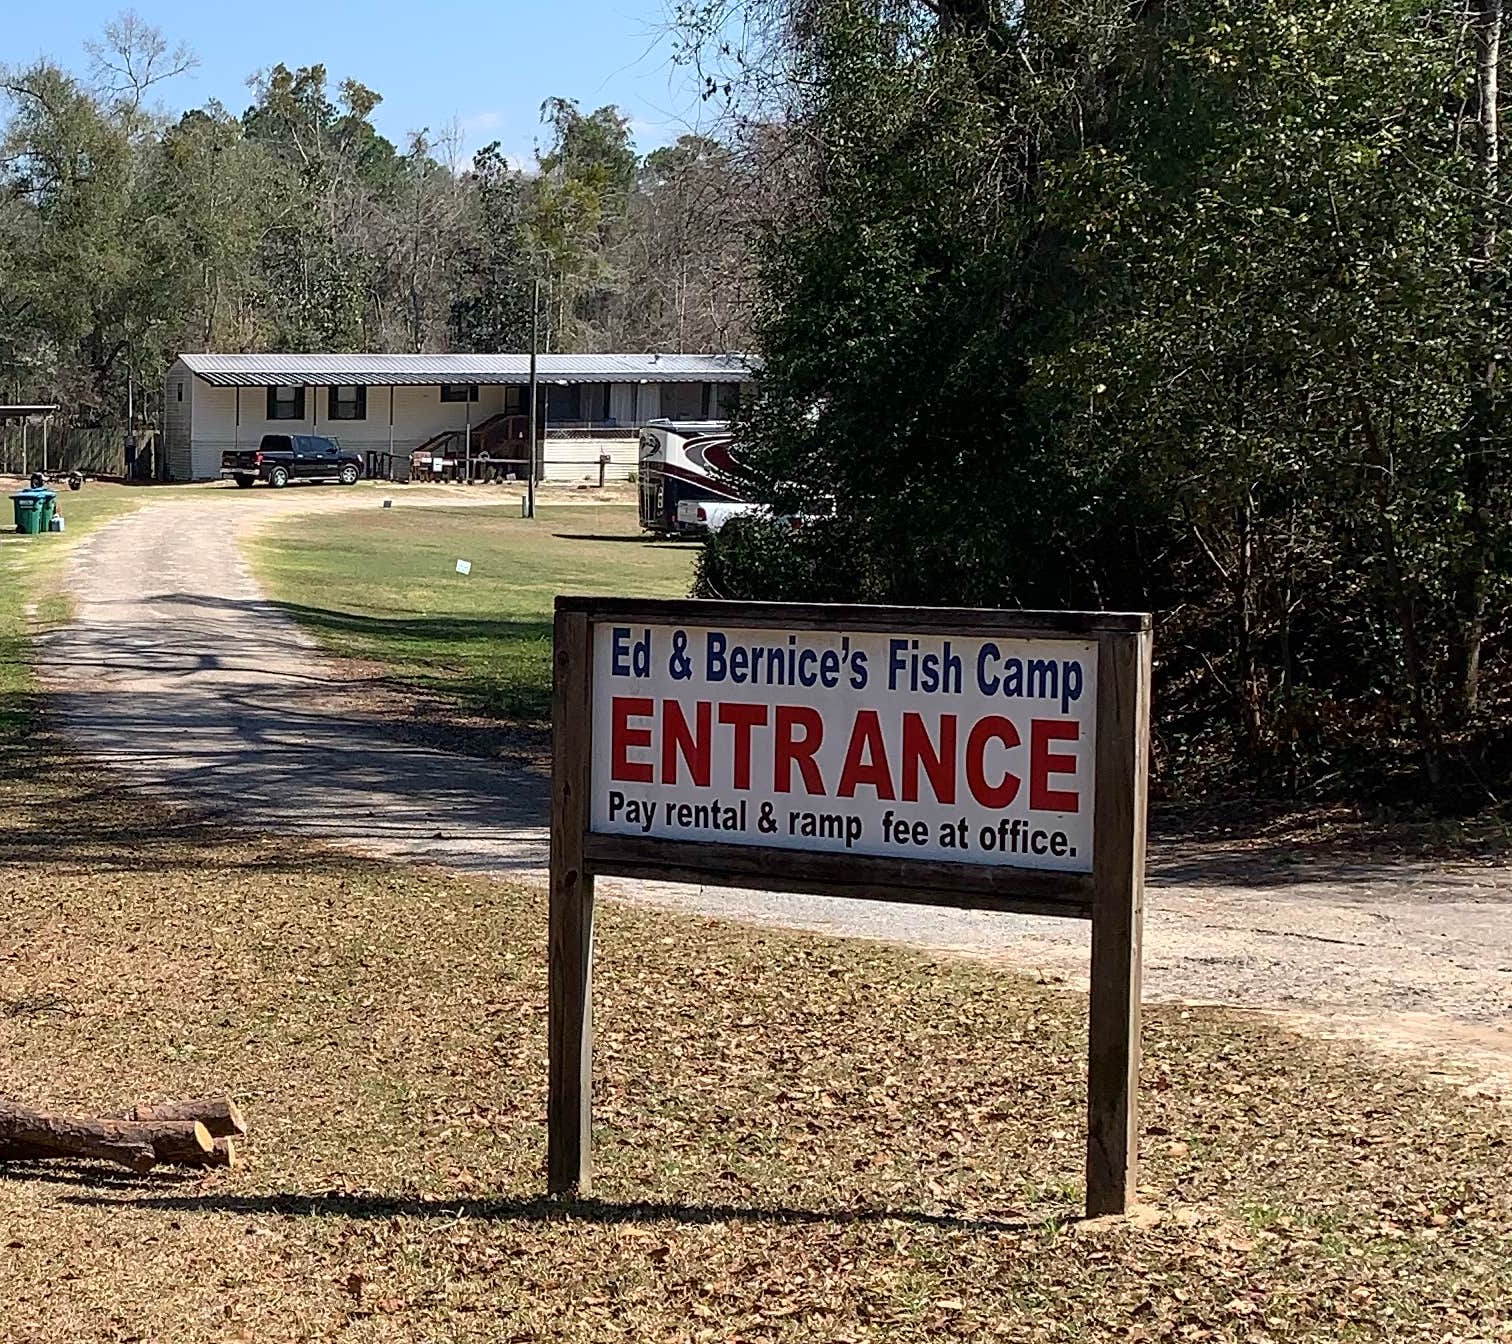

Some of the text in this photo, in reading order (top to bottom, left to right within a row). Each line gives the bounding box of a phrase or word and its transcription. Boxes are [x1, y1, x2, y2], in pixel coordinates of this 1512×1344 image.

[610, 626, 1085, 715] Ed & Bernice's Fish Camp
[610, 695, 1081, 814] ENTRANCE
[608, 790, 1078, 859] Pay rental & ramp fee at office.
